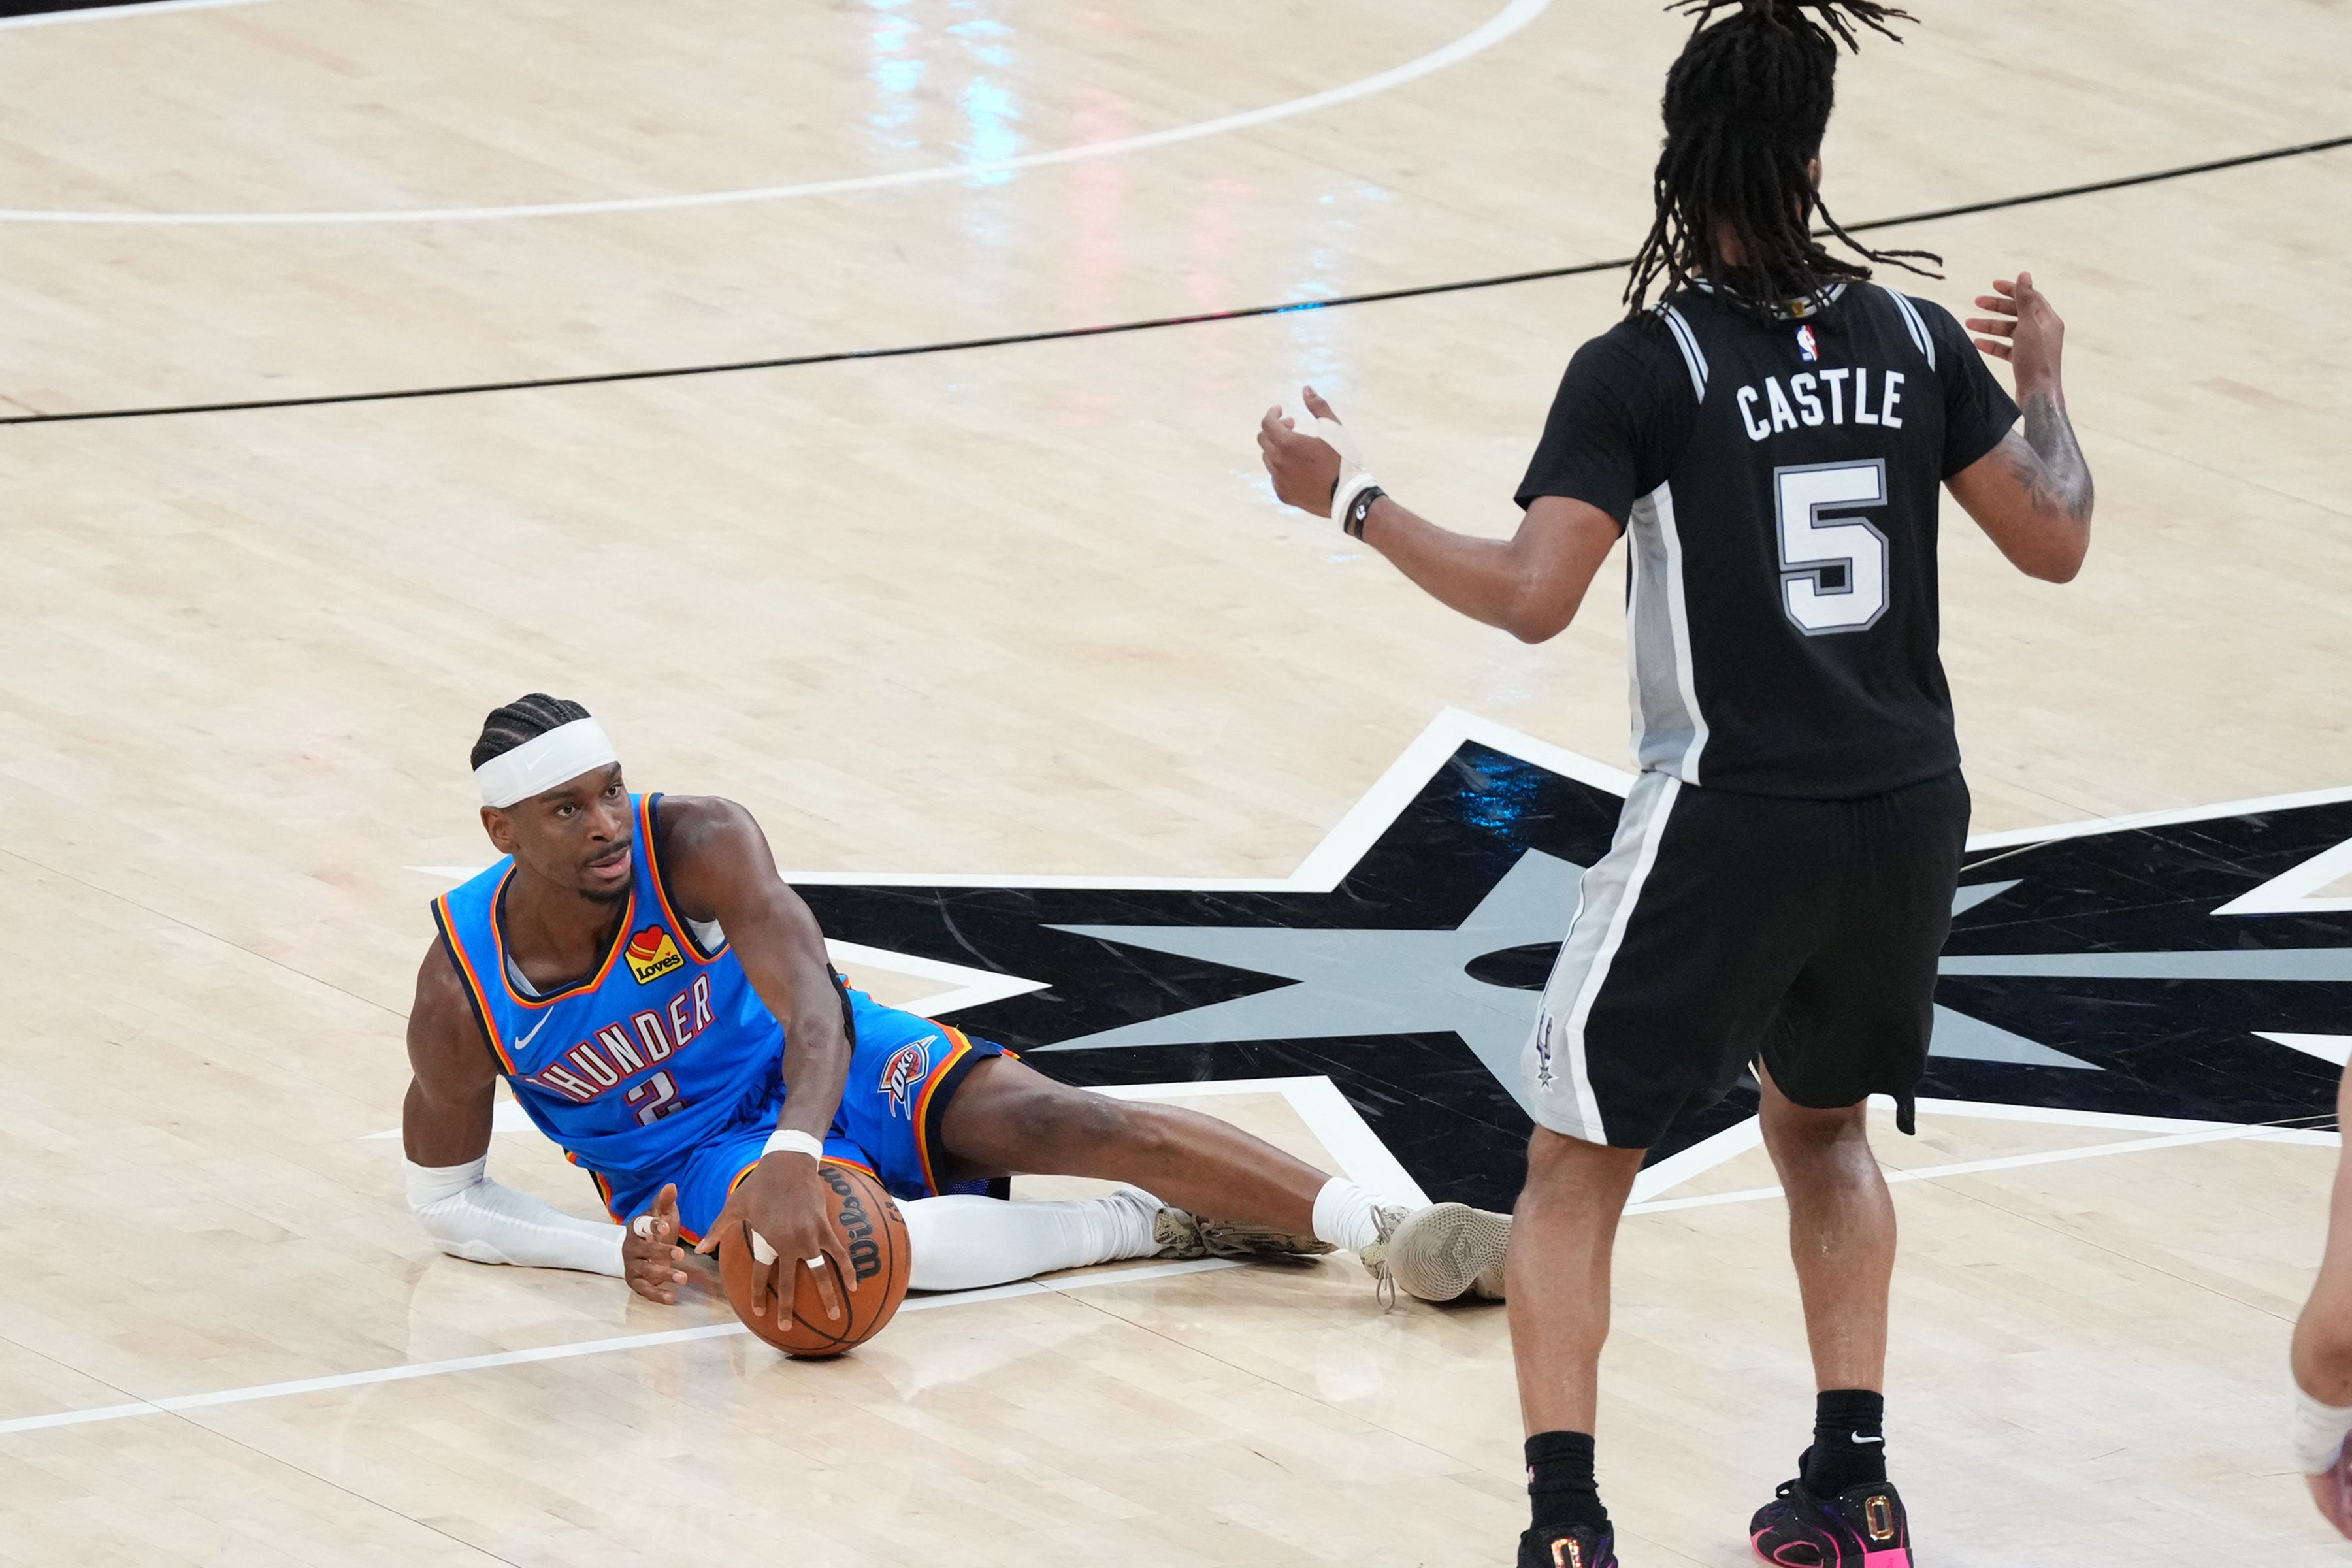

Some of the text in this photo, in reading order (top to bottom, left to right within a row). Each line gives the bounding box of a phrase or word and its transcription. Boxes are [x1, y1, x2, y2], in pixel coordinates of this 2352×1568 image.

[1737, 367, 1905, 442] CASTLE
[1773, 457, 1890, 636] 5
[625, 1069, 691, 1128] 2
[890, 1049, 915, 1100] OKC
